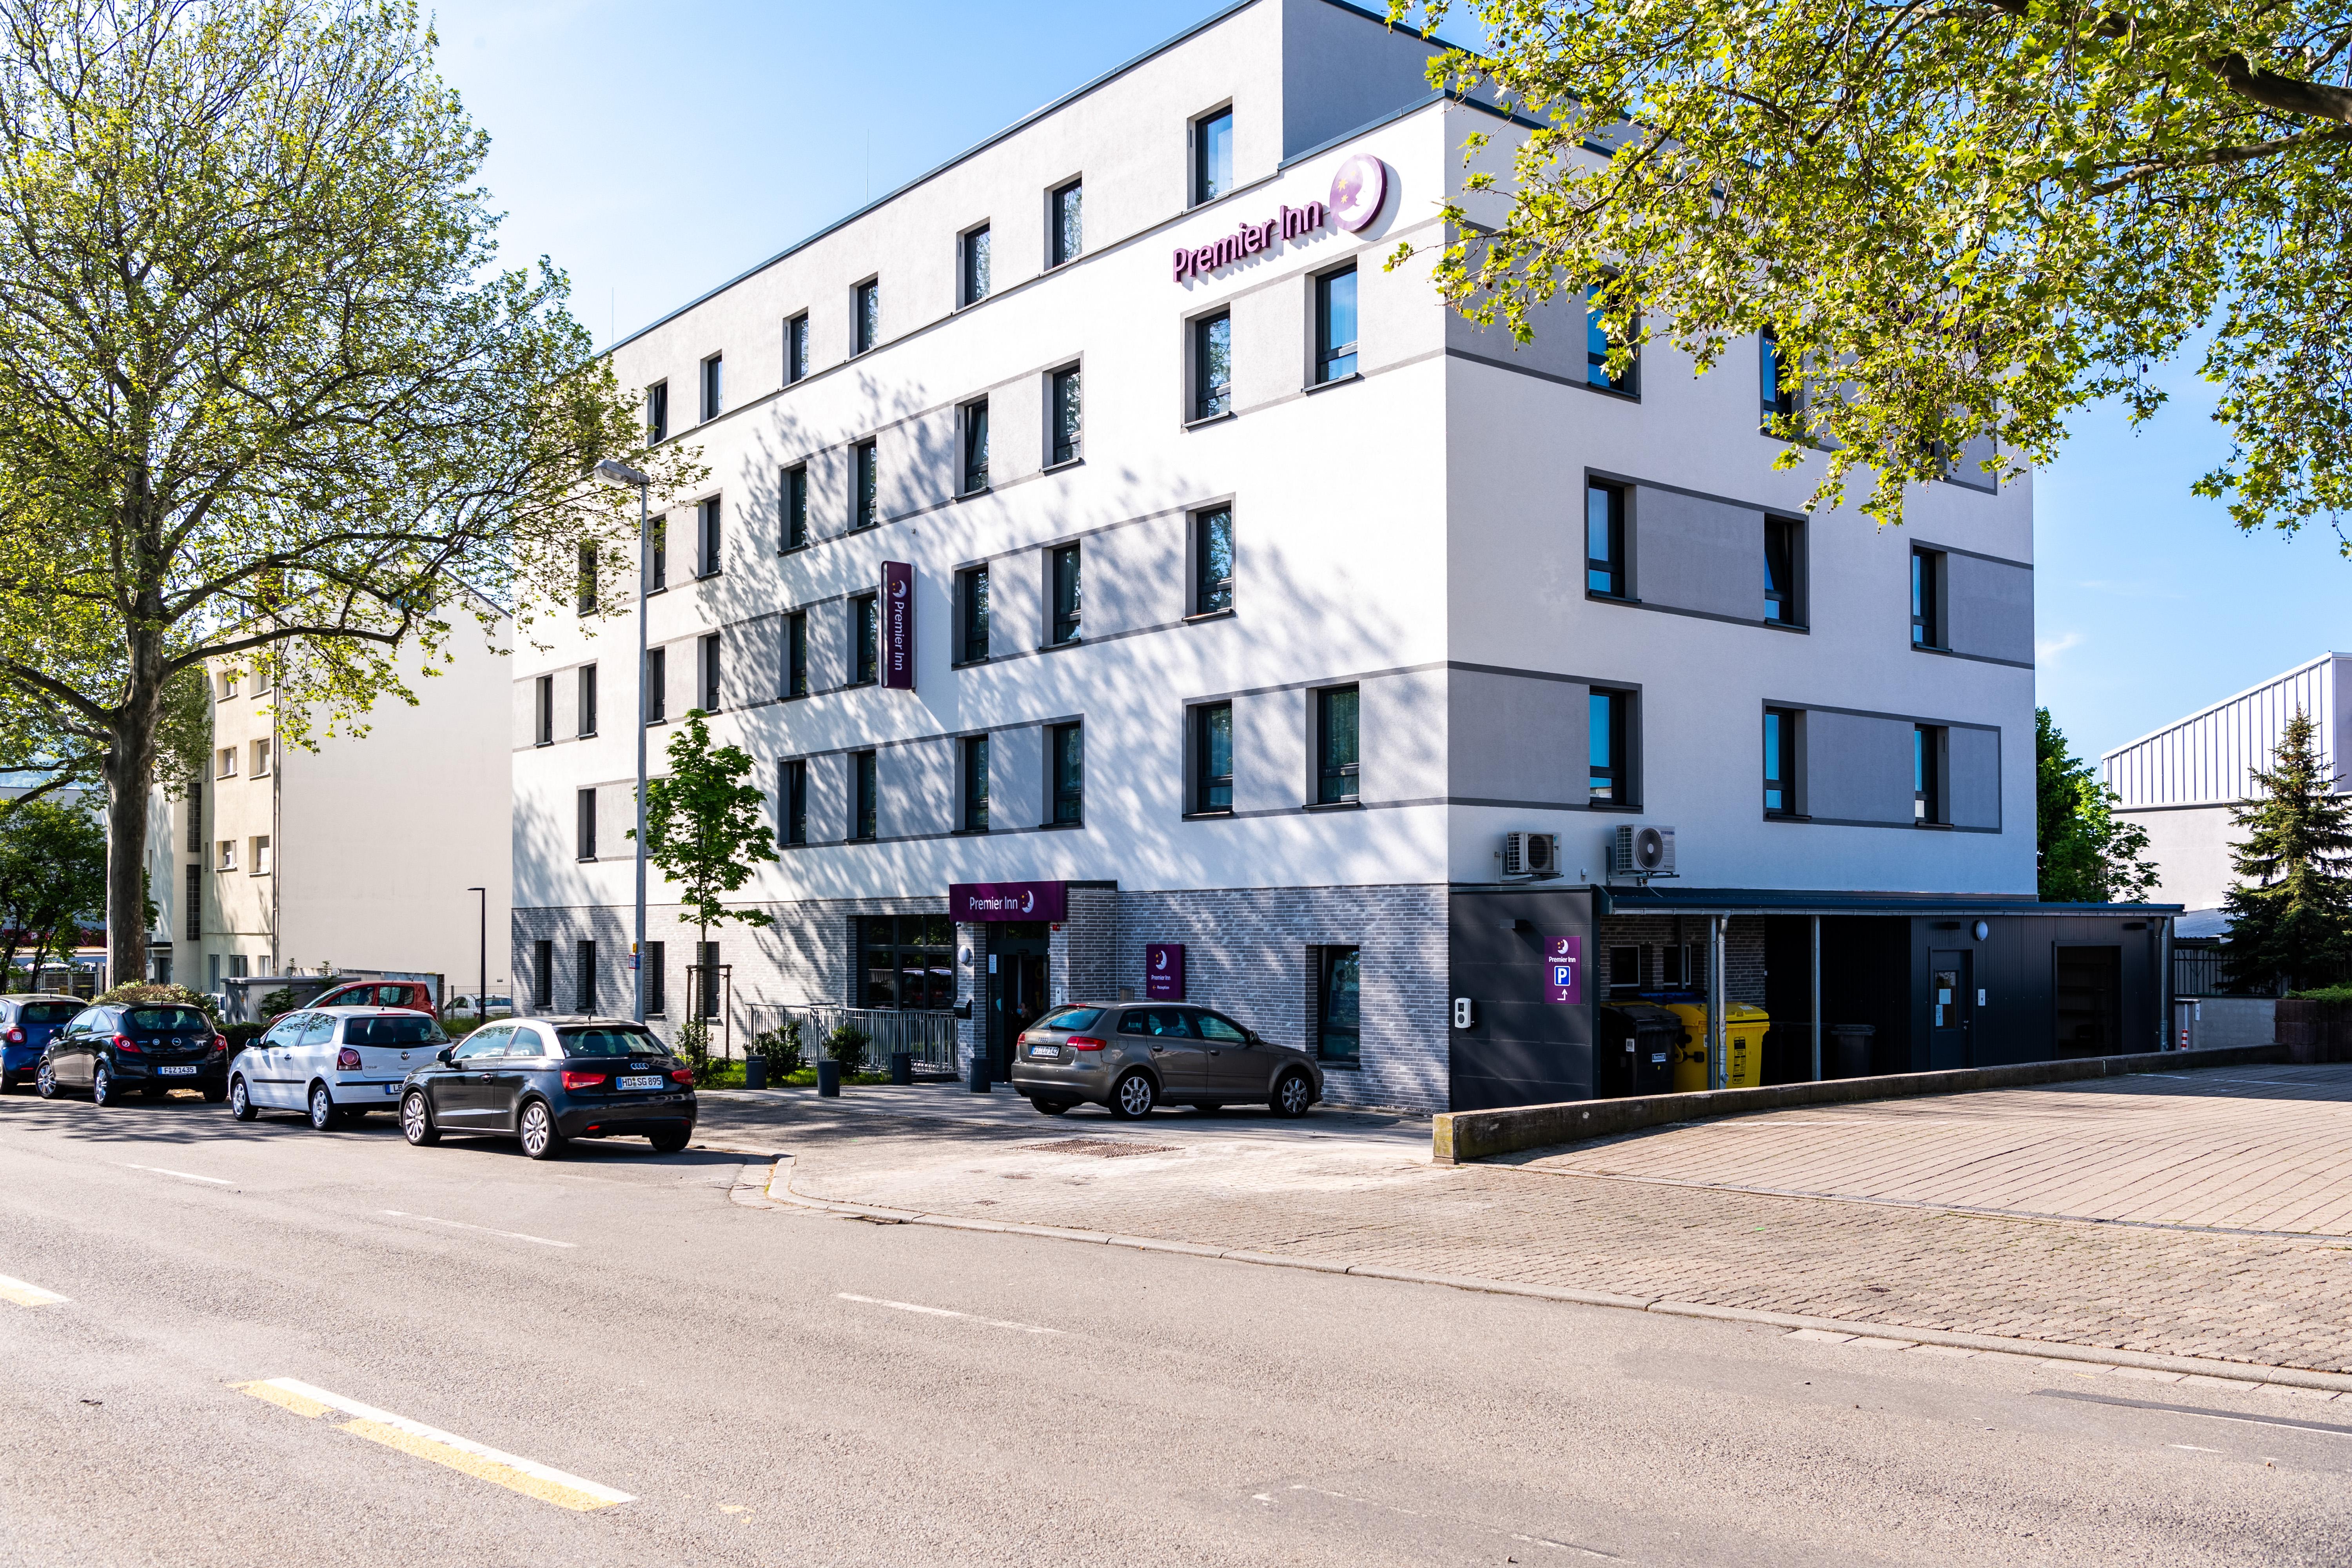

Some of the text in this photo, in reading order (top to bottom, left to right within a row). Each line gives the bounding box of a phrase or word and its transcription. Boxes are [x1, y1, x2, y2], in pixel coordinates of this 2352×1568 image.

[1173, 201, 1323, 283] Premier Inn
[895, 601, 904, 670] Premier Inn
[970, 896, 1018, 910] Premier Inn
[1558, 968, 1567, 984] P
[622, 1077, 662, 1087] HD SG 895
